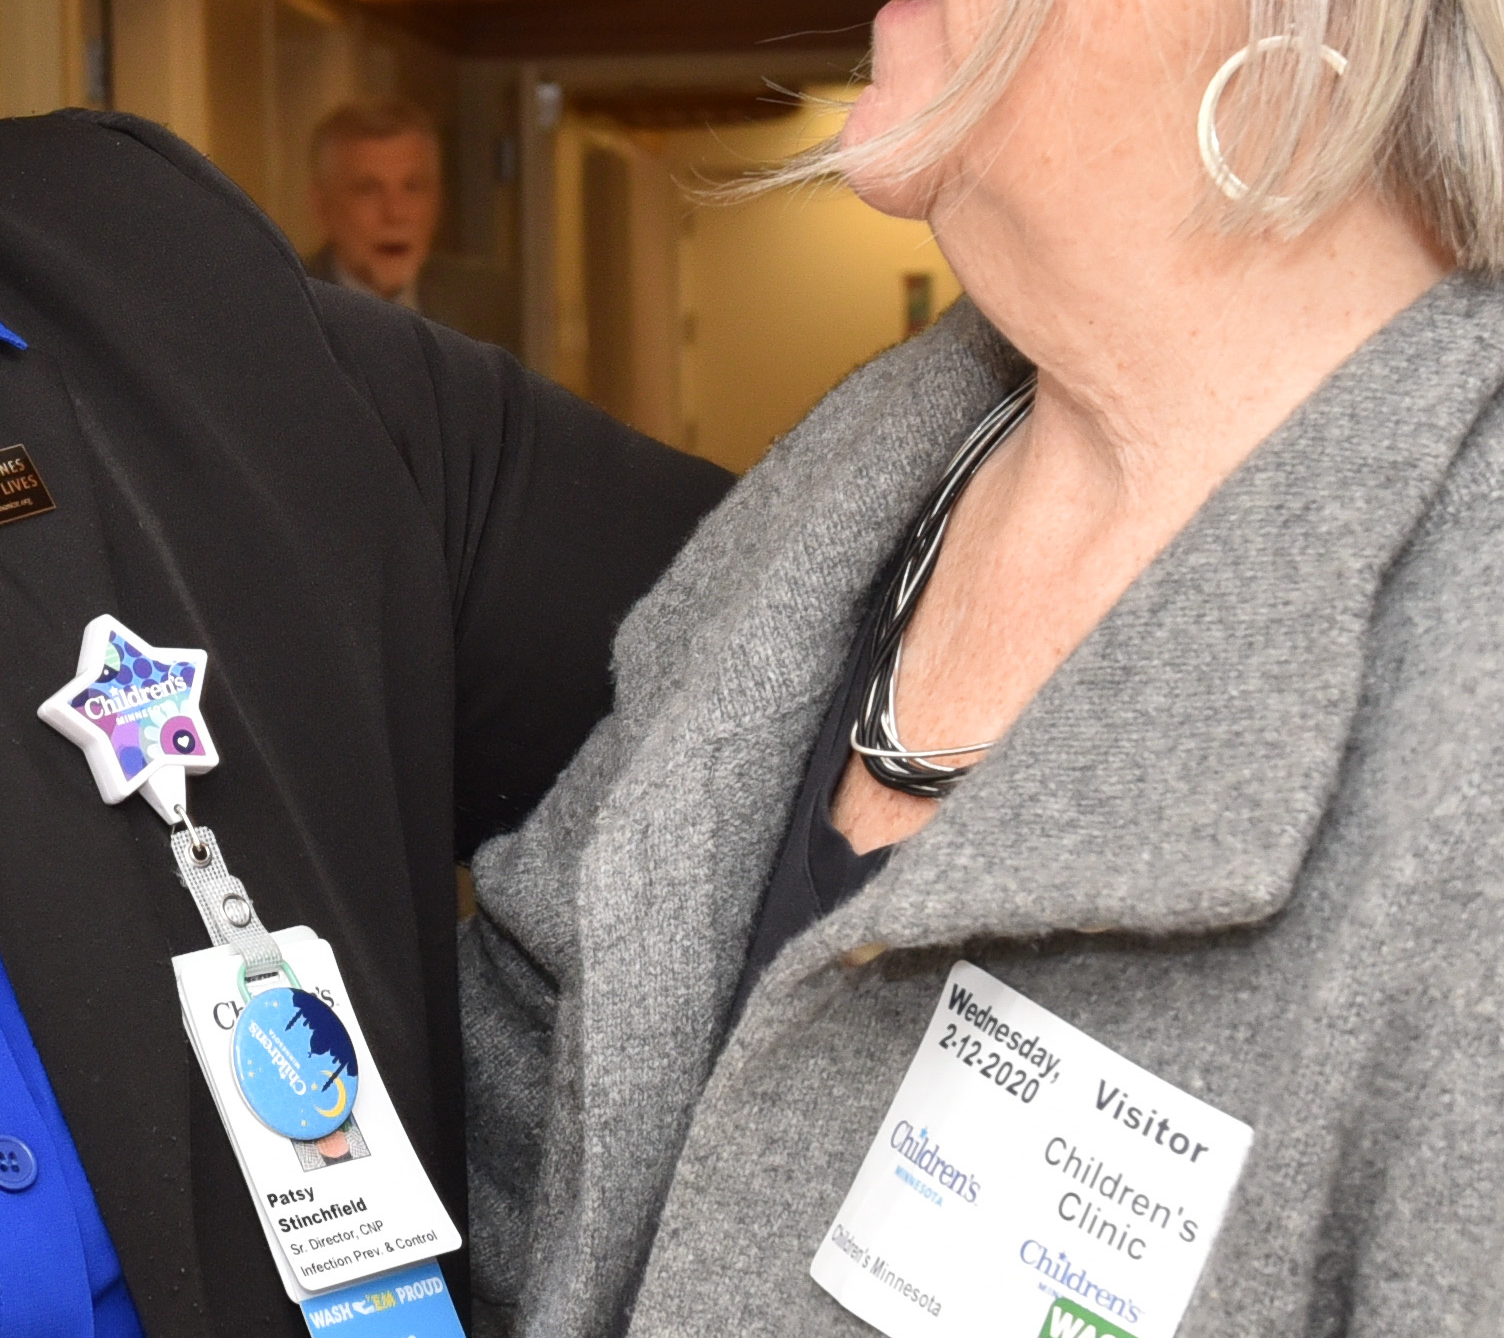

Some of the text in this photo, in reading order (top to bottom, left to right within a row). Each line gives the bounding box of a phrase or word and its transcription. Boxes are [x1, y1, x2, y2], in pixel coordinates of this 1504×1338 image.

[0, 474, 38, 496] LIVES
[84, 676, 187, 720] Children's
[248, 1020, 307, 1095] Children's
[269, 1029, 300, 1069] MINNESOTA
[939, 1023, 1040, 1103] 2-12-2020
[948, 983, 1061, 1083] Wednesday,
[1095, 1079, 1209, 1163] Visitor
[890, 1120, 981, 1203] Children's
[894, 1165, 943, 1207] MINNESOTA
[1045, 1137, 1198, 1242] Children's
[266, 1187, 315, 1208] Patsy
[278, 1197, 368, 1233] Stinchfield
[1058, 1192, 1147, 1260] Clinic
[290, 1220, 383, 1256] Sr. Director, CNP
[300, 1230, 438, 1277] Infection Prev. & Control
[831, 1224, 942, 1317] Children's Minnesota
[1020, 1239, 1139, 1324] Children's
[309, 1302, 354, 1329] WASH
[395, 1276, 444, 1304] PROUD
